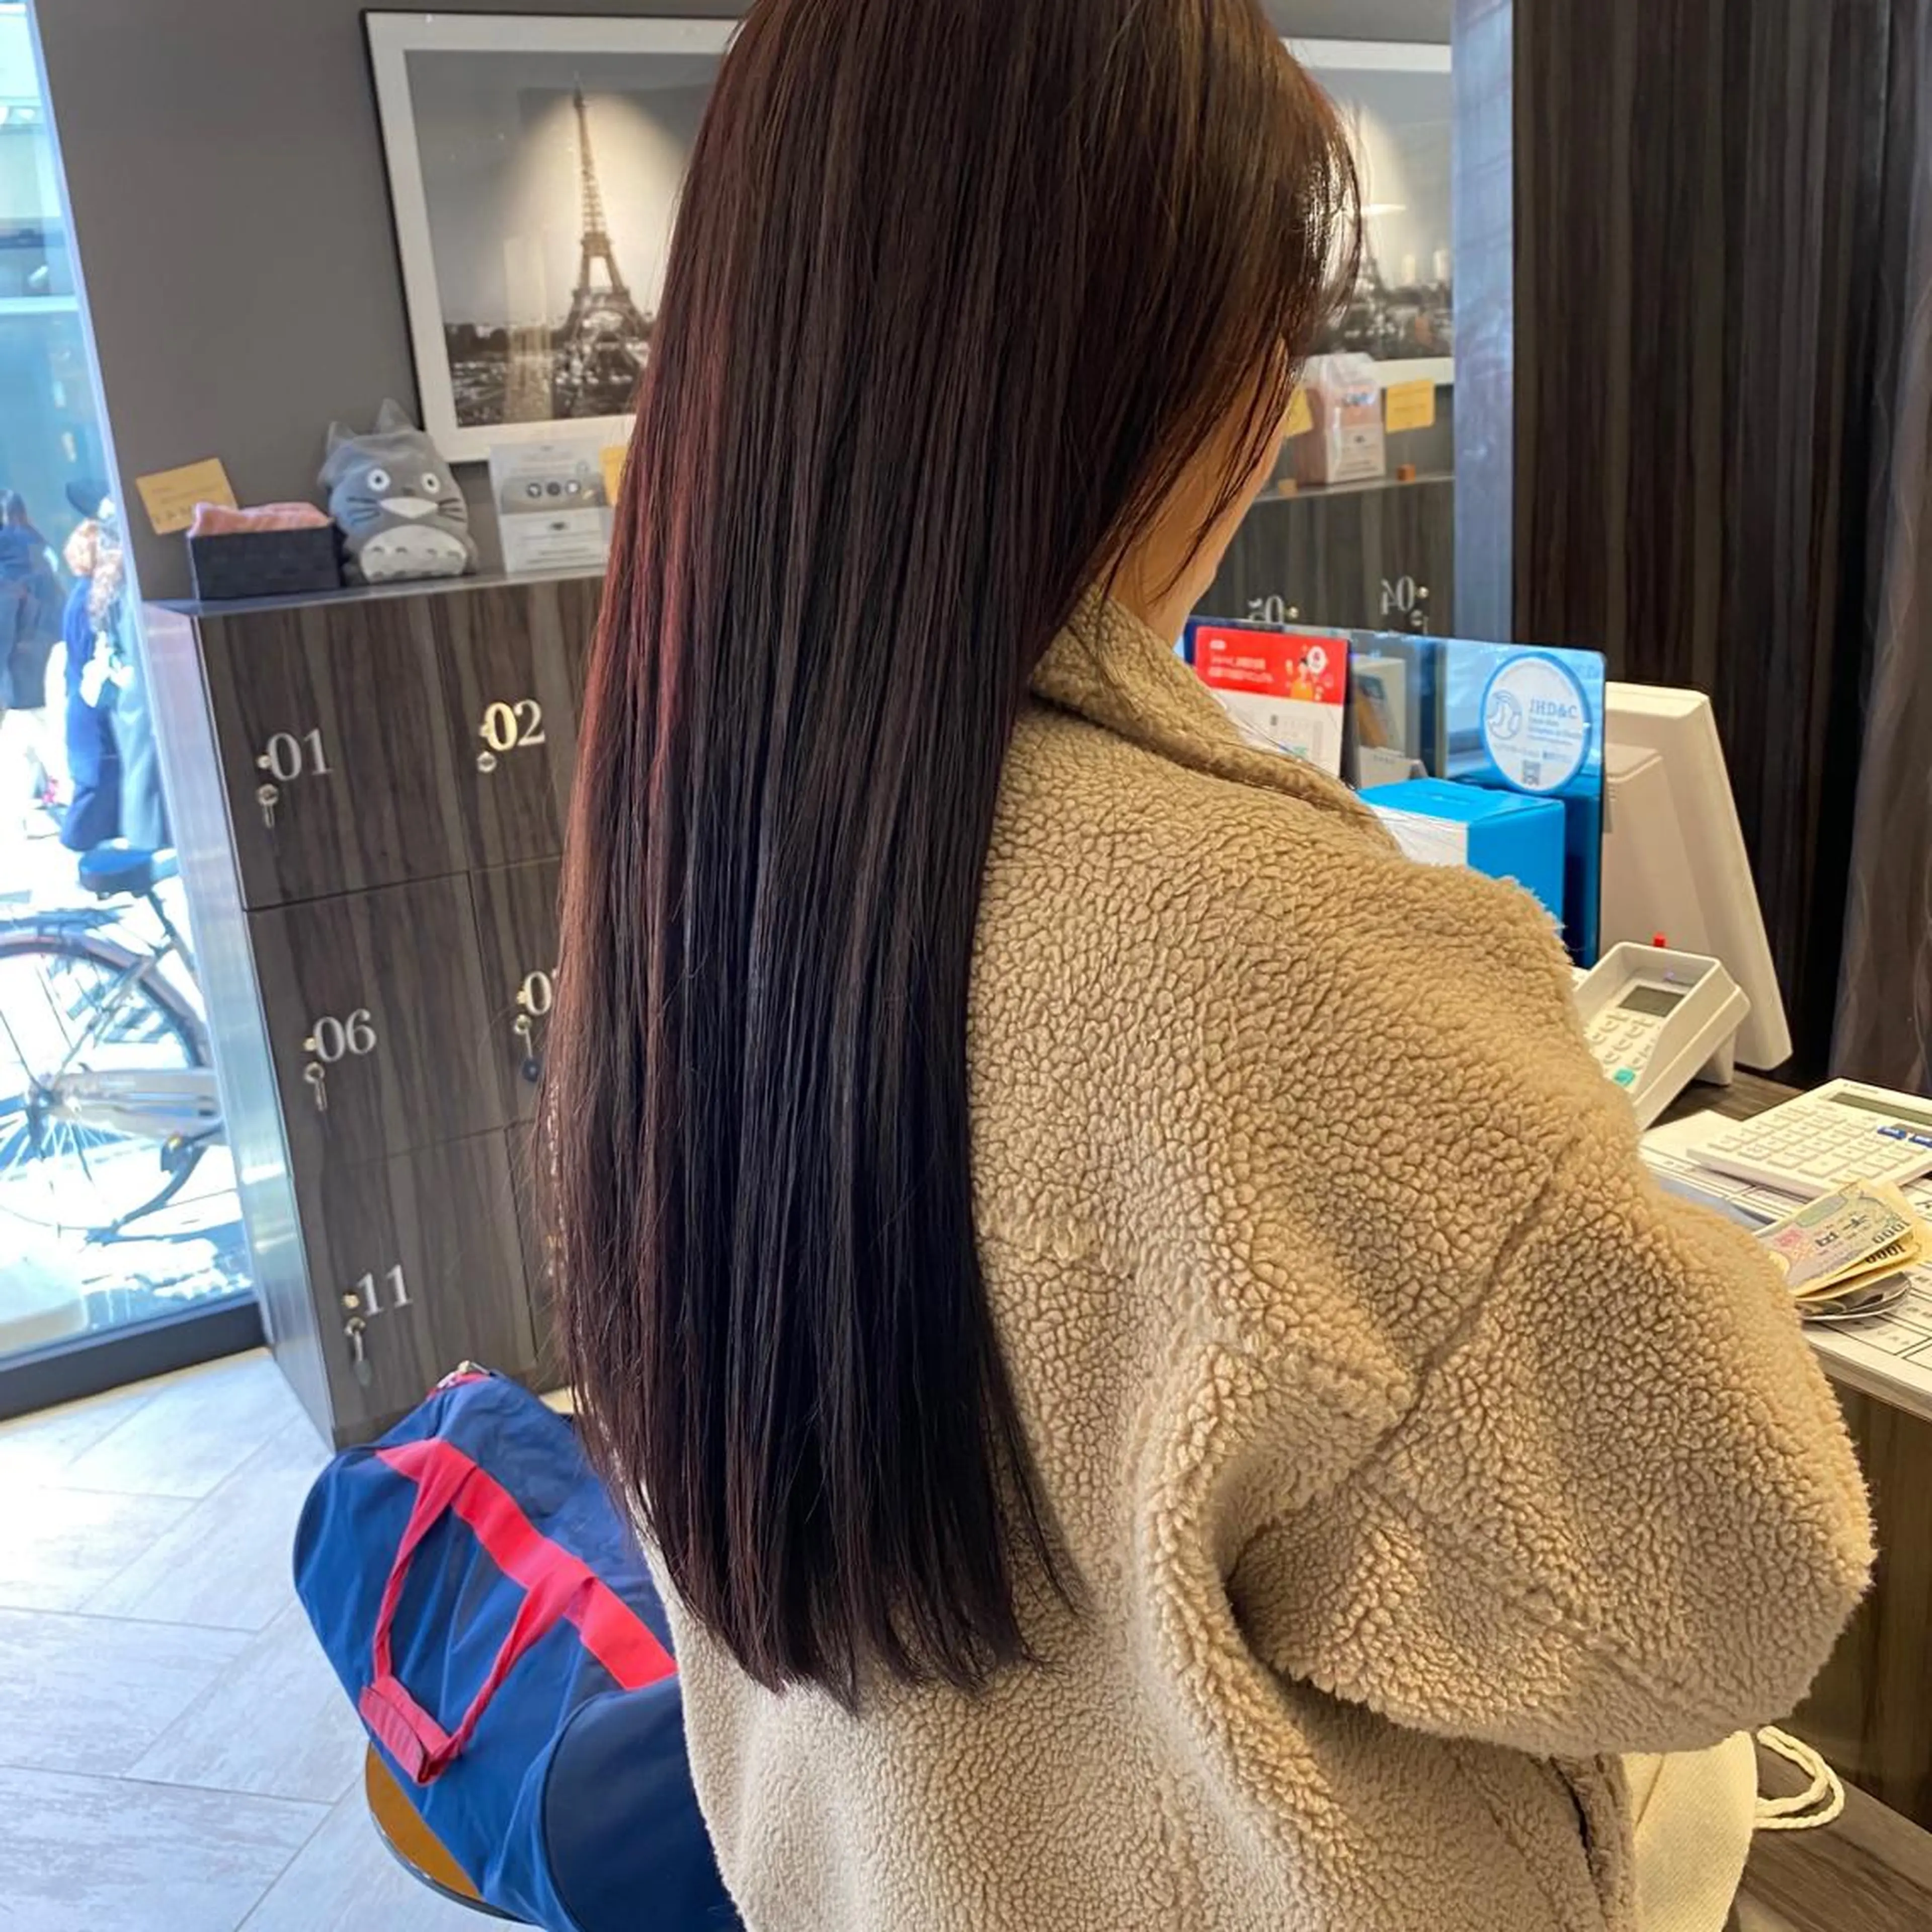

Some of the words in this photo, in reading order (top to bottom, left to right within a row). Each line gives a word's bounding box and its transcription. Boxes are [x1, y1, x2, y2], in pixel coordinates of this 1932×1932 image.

[484, 700, 545, 751] 02
[267, 728, 332, 781] 01
[524, 967, 558, 1015] 0
[313, 1008, 376, 1062] 06
[357, 1264, 413, 1317] 11
